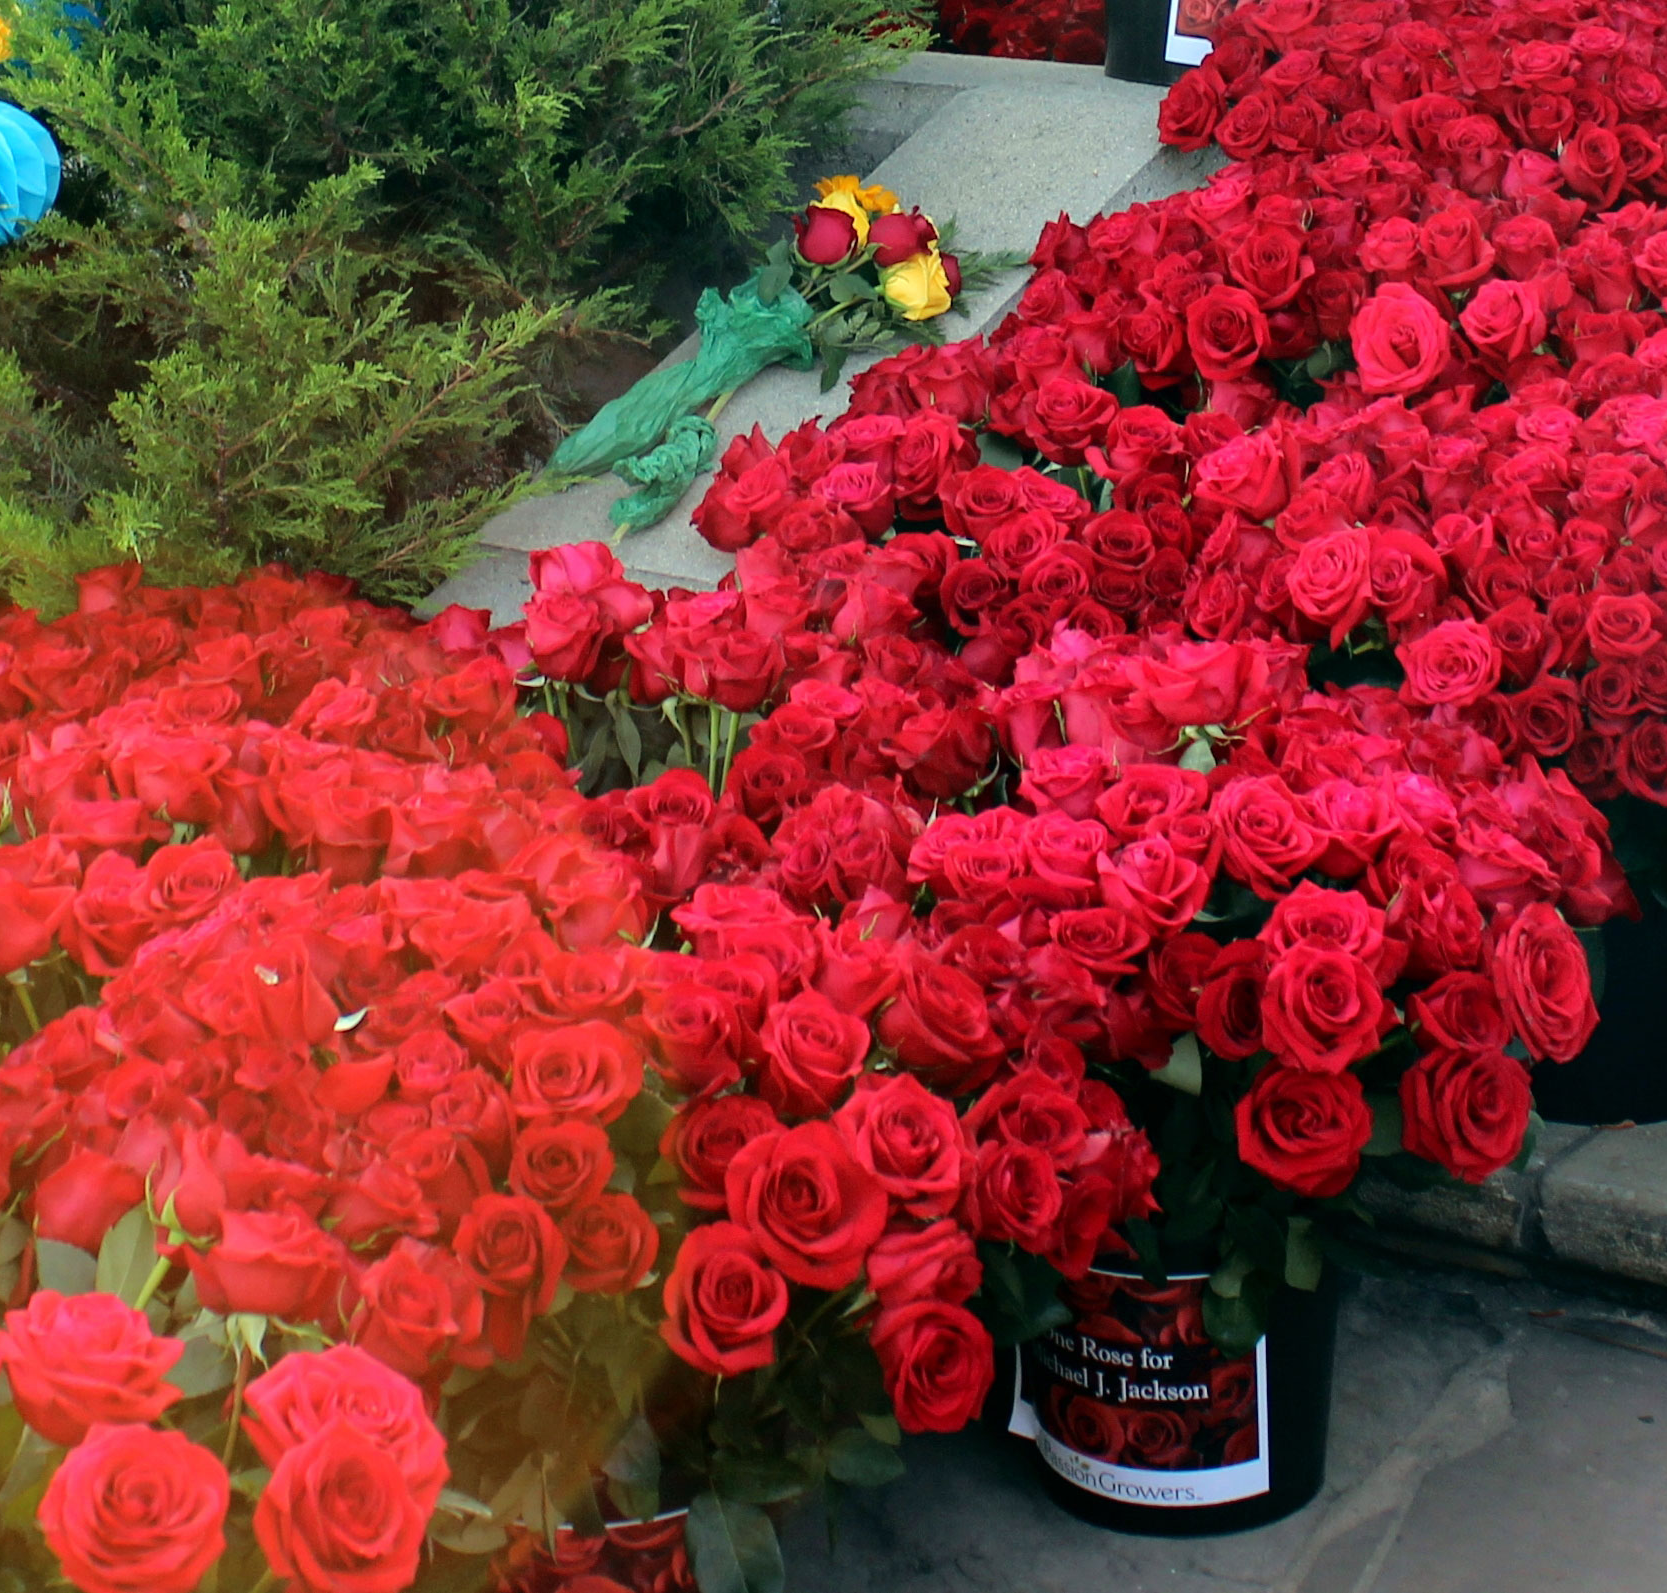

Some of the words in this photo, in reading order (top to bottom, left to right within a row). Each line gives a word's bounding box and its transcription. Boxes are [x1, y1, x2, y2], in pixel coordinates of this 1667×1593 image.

[1081, 1336, 1133, 1367] Rose
[1140, 1347, 1173, 1370] for
[1095, 1371, 1110, 1398] J.
[1118, 1376, 1209, 1403] Jackson
